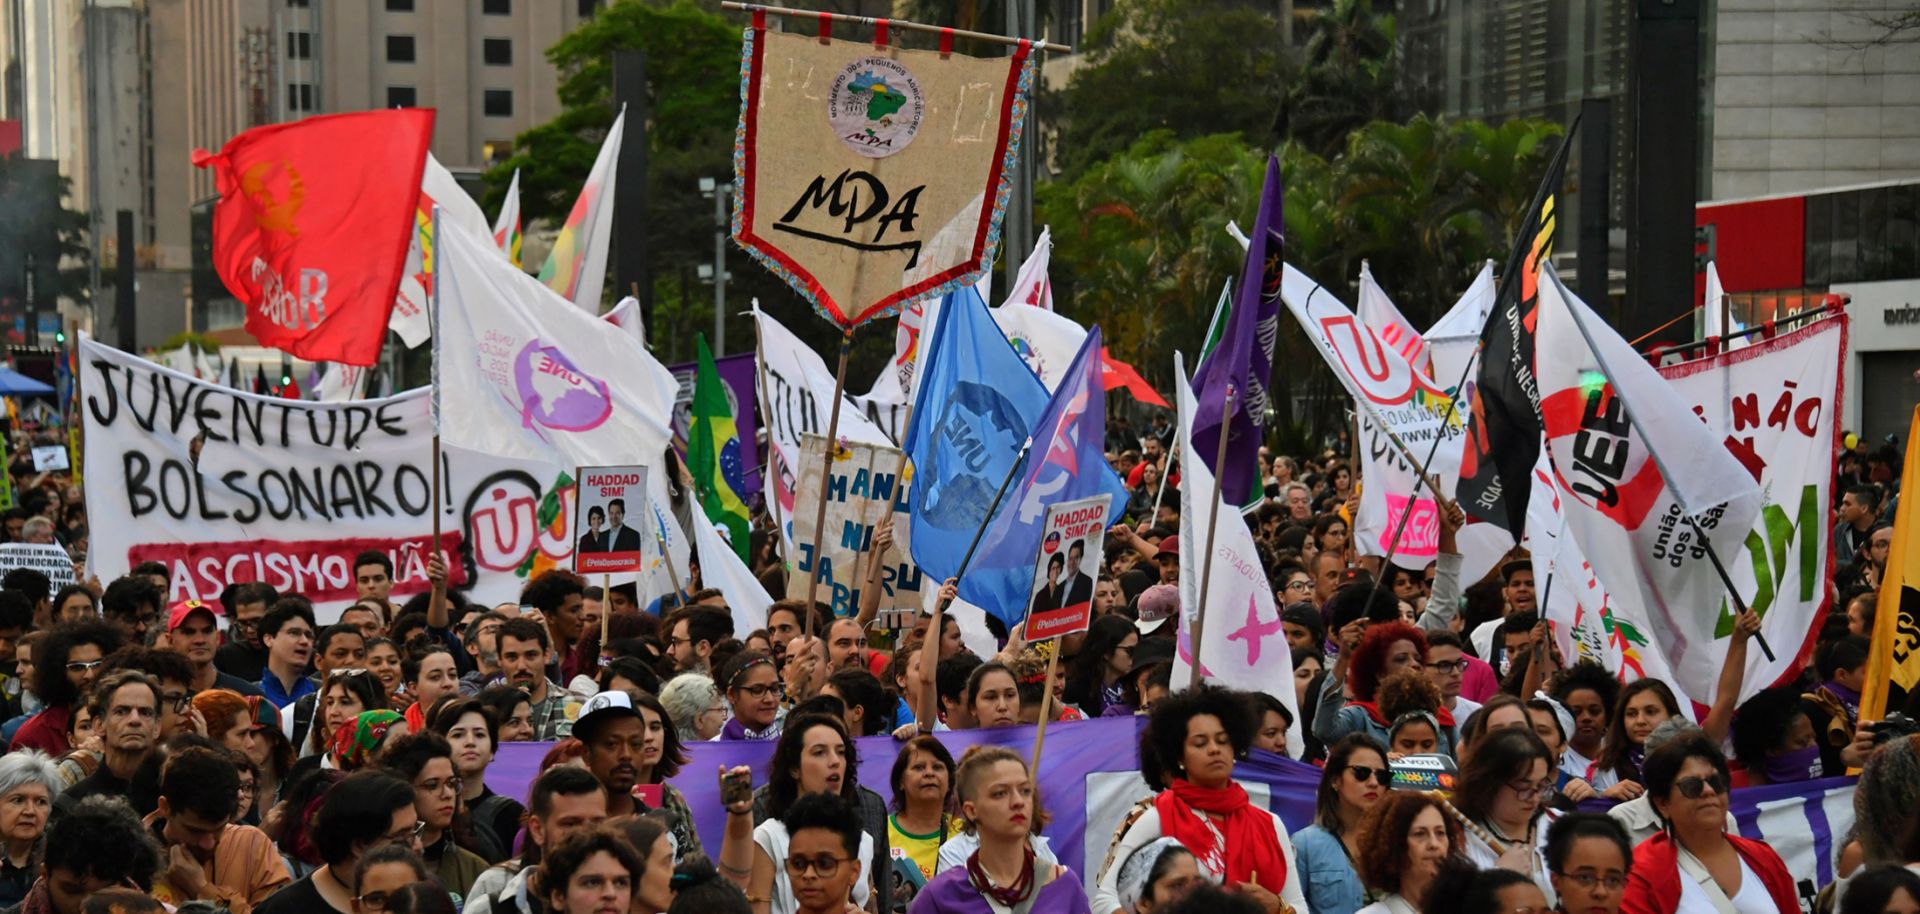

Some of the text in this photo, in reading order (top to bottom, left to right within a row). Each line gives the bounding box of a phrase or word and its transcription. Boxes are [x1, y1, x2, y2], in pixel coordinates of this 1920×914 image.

[89, 360, 408, 450] JUVENTUDE
[1731, 380, 1822, 438] NÃO
[587, 474, 640, 487] HADDAD
[600, 487, 625, 498] SIM!
[1053, 505, 1104, 529] HADDAD
[1065, 523, 1088, 540] SIM!
[1653, 503, 1682, 560] União
[1668, 529, 1692, 568] dos
[163, 551, 349, 601] ASCISMO
